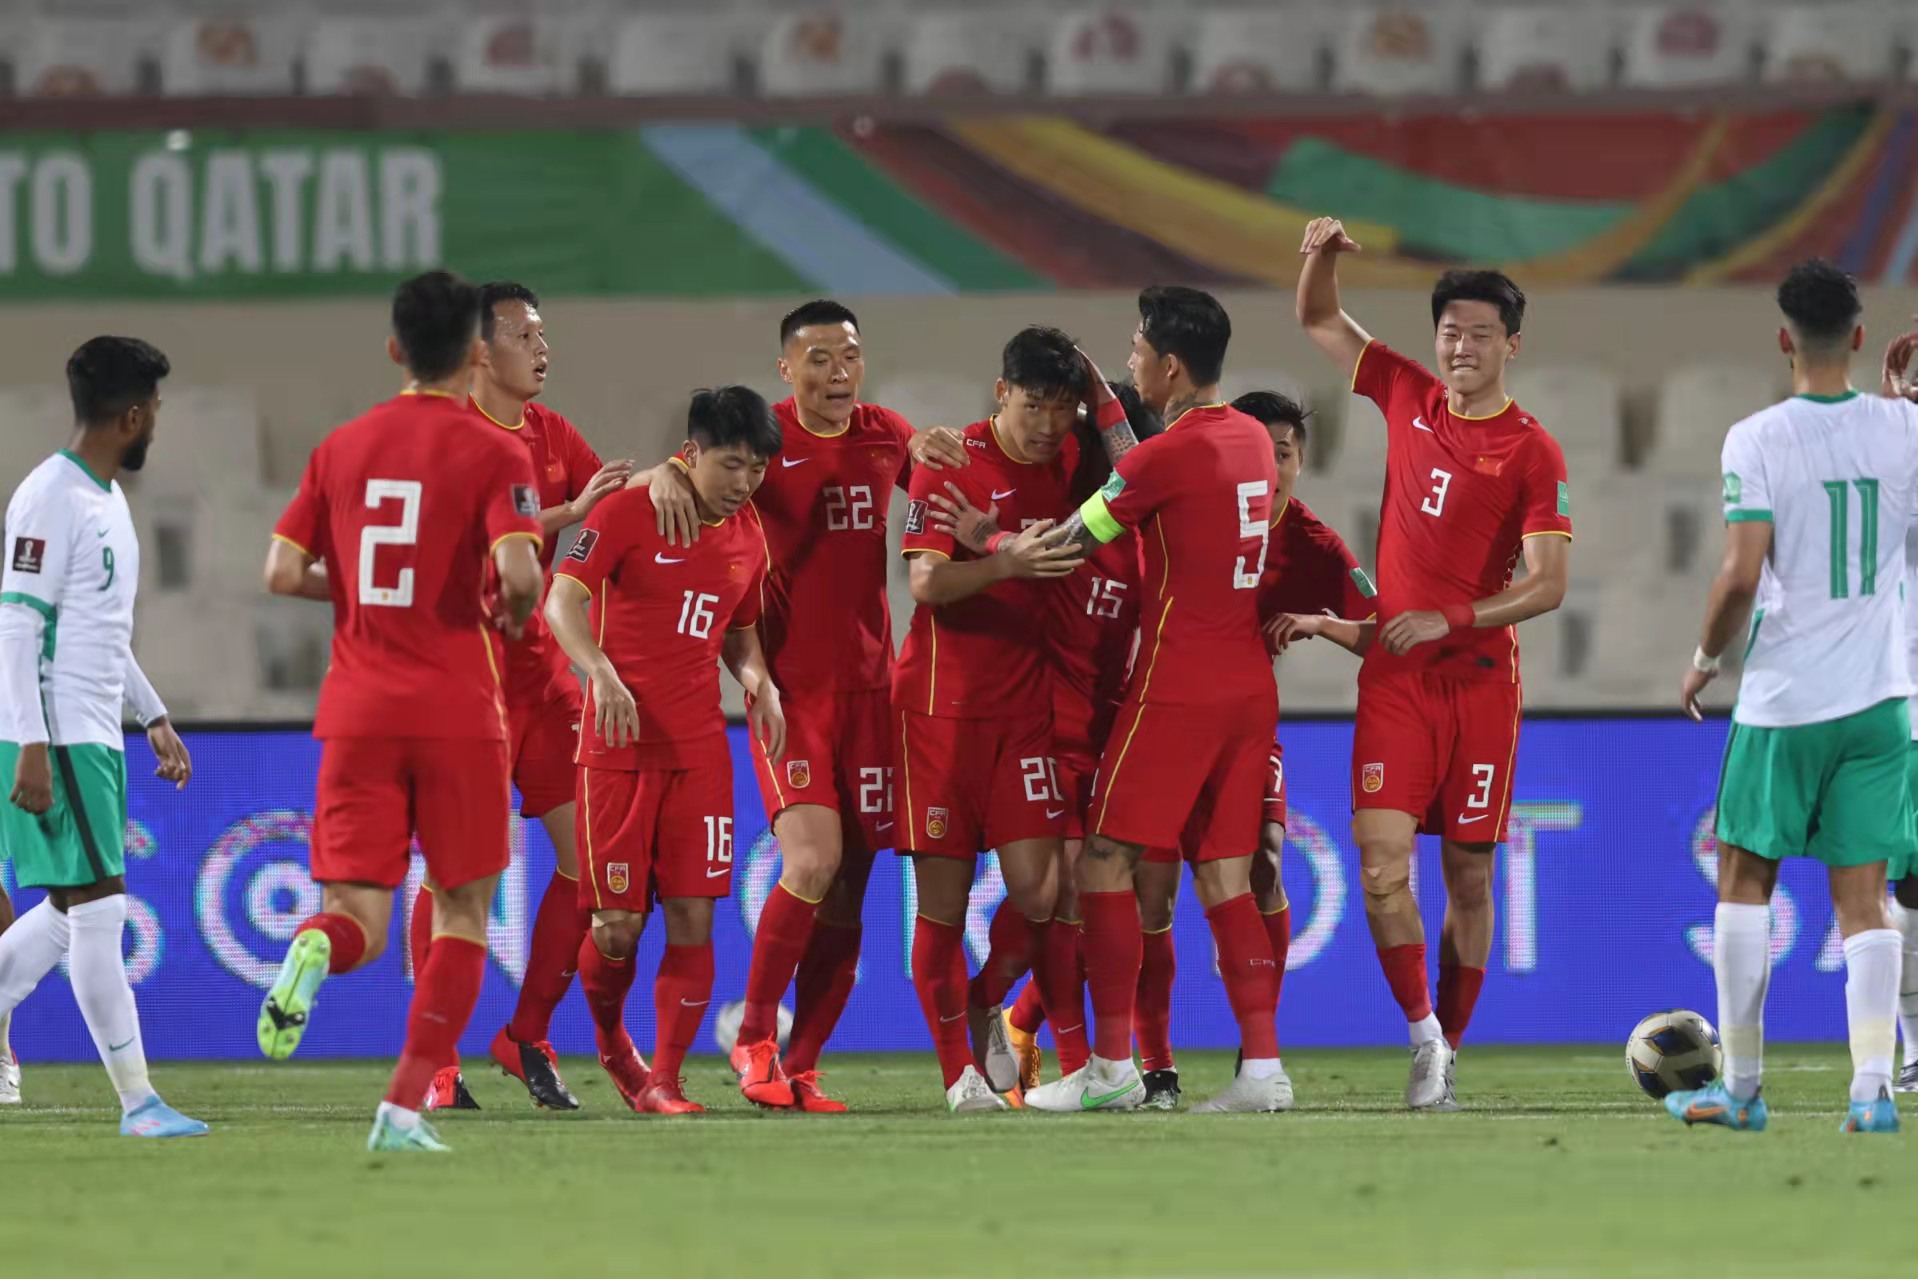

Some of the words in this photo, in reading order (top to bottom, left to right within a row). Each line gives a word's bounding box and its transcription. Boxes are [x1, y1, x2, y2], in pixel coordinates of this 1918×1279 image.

[129, 147, 443, 282] QATAR
[966, 438, 986, 449] CFA
[823, 485, 873, 531] 22
[1421, 467, 1452, 517] 3
[359, 478, 422, 607] 2
[1233, 480, 1269, 589] 5
[1822, 478, 1878, 599] 11
[97, 546, 115, 592] 9
[677, 590, 719, 639] 16
[1086, 576, 1128, 619] 15
[1467, 763, 1495, 808] 3
[703, 815, 732, 862] 16
